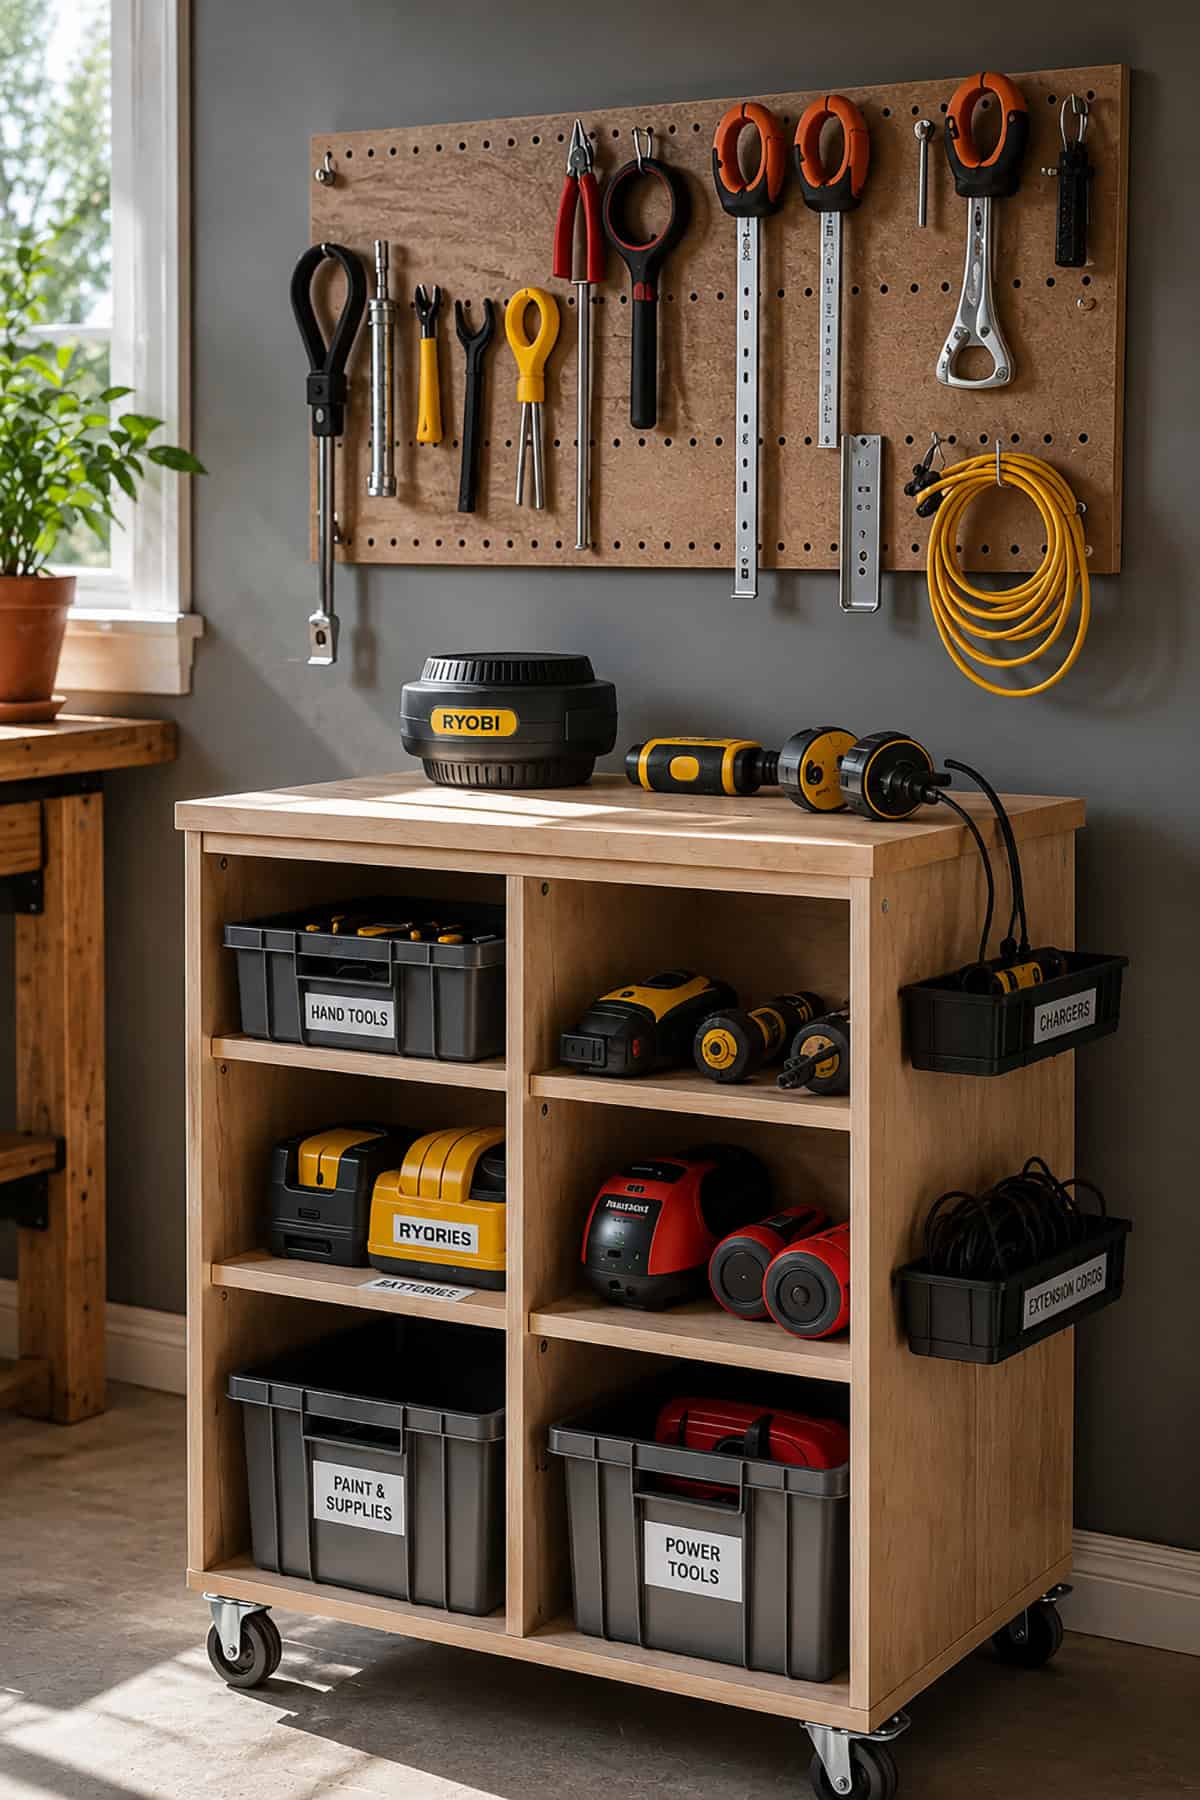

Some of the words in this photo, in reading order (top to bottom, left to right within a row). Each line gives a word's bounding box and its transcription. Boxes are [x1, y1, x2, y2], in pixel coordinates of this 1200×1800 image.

[443, 714, 500, 730] RYOBI
[311, 1004, 345, 1021] HAND
[347, 1008, 388, 1026] TOOLS
[1040, 1000, 1090, 1031] CHARGERS
[399, 1222, 471, 1246] RYORIES
[1028, 1279, 1075, 1316] EXTENSION
[334, 1475, 372, 1496] PAINT
[376, 1483, 385, 1499] &
[326, 1495, 392, 1521] SUPPLIES
[665, 1537, 720, 1562] POWER
[667, 1560, 719, 1585] TOOLS
